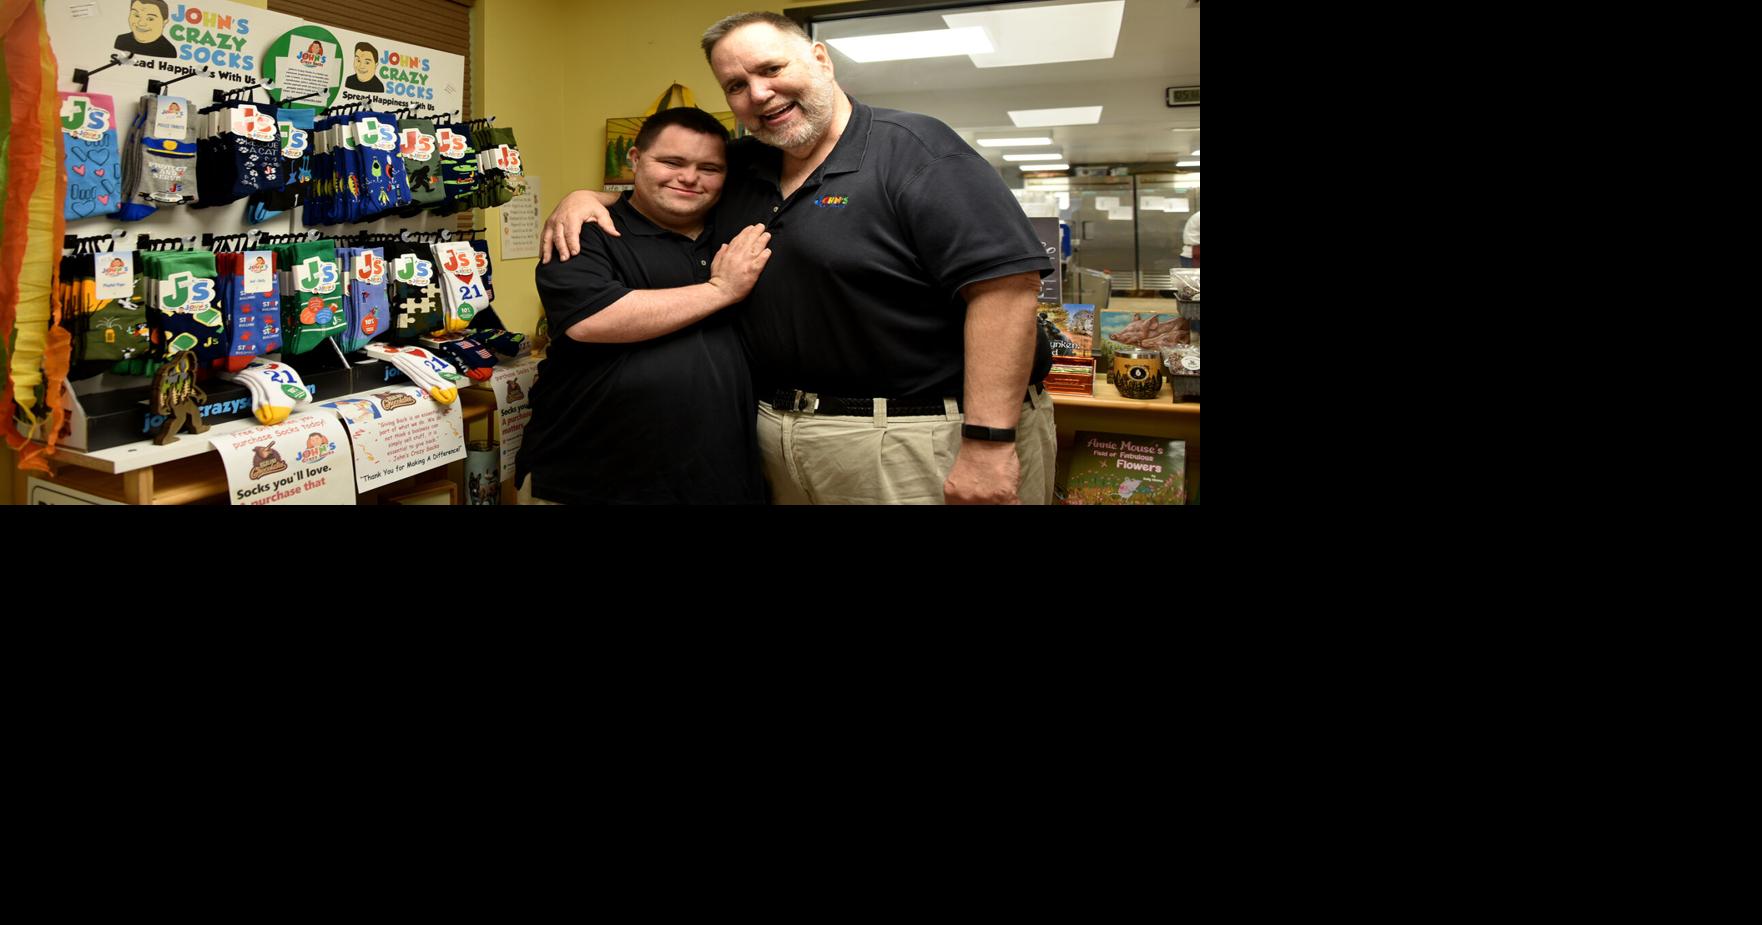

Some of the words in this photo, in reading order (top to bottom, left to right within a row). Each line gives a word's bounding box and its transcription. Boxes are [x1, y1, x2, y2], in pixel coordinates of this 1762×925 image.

[171, 4, 249, 34] JOHN'S
[170, 24, 247, 52] CRAZY
[179, 44, 254, 71] SOCKS
[380, 50, 430, 72] JOHN'S
[218, 71, 242, 82] With
[245, 75, 256, 84] Us
[379, 66, 428, 86] CRAZY
[386, 82, 433, 100] SOCKS
[372, 96, 408, 107] Happiness
[459, 284, 483, 300] 21
[424, 356, 449, 373] 21
[264, 370, 298, 384] 21
[1088, 438, 1117, 450] Annie
[1120, 441, 1163, 454] Mouse's
[406, 458, 426, 468] Making
[1120, 452, 1154, 462] Fabulous
[1116, 460, 1162, 472] Flowers
[237, 483, 270, 500] Socks
[274, 470, 303, 491] you'll
[306, 464, 332, 478] love.
[304, 478, 326, 490] that
